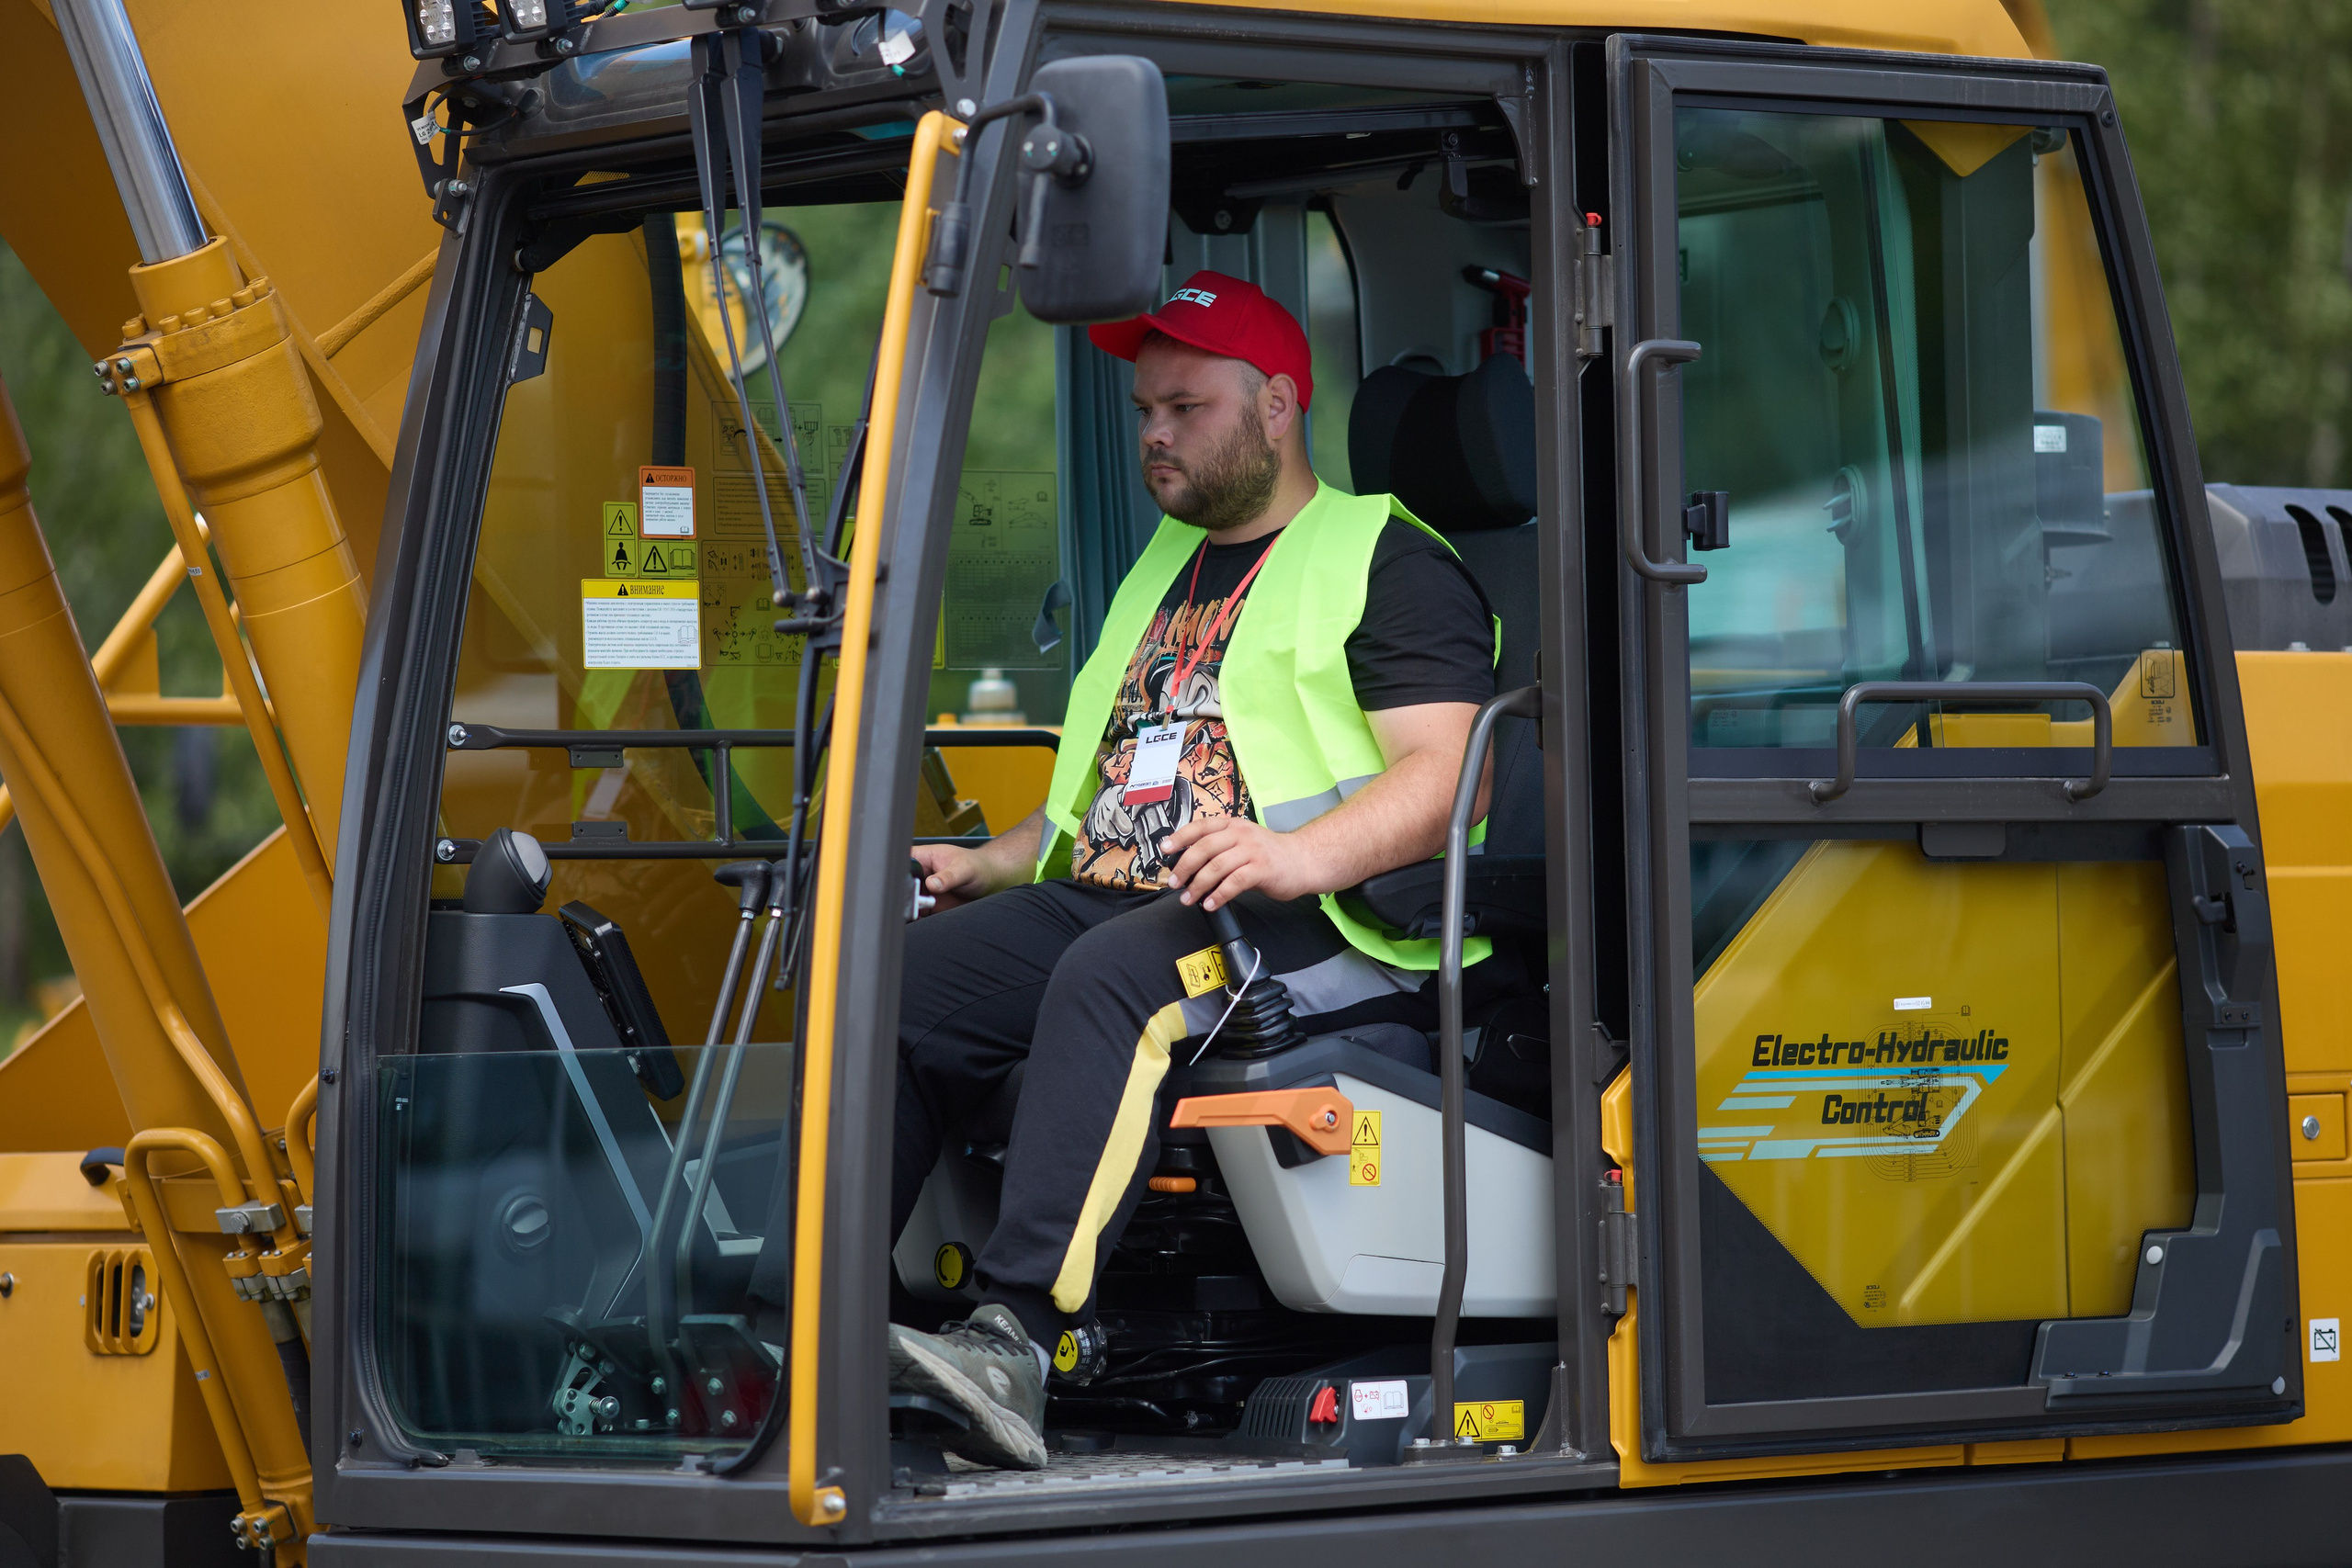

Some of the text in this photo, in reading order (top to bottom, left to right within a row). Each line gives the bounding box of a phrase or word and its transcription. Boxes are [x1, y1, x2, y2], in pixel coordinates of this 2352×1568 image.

[1164, 288, 1217, 308] GCE
[1145, 731, 1178, 744] LGCE
[1752, 1029, 2008, 1067] Electro-Hydraulic
[1821, 1091, 1928, 1125] Control
